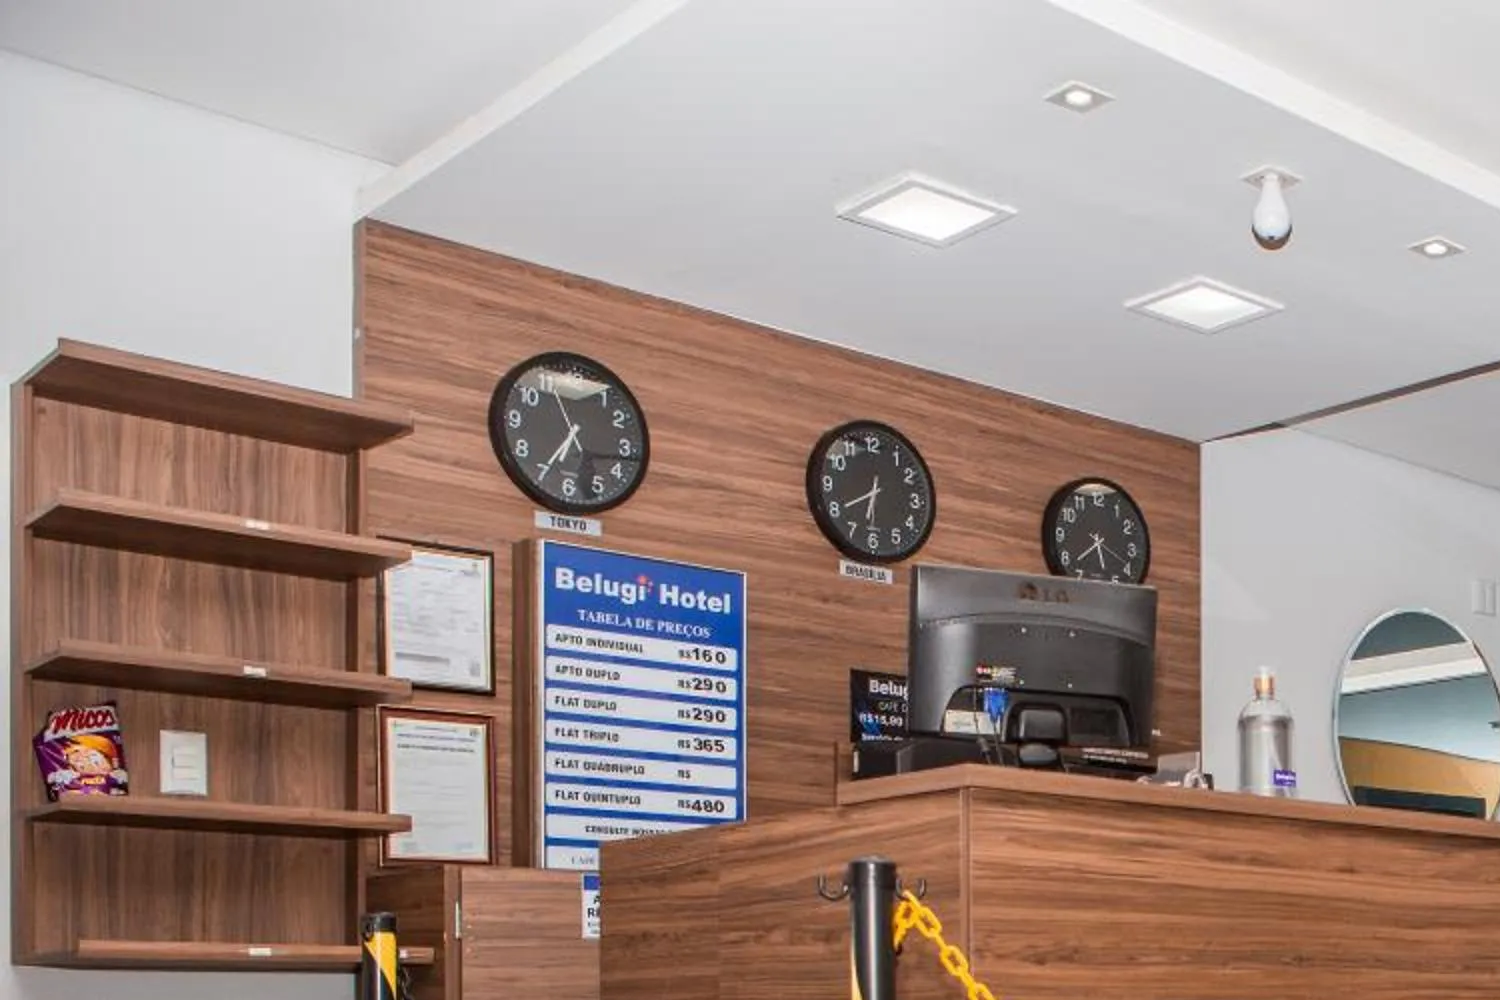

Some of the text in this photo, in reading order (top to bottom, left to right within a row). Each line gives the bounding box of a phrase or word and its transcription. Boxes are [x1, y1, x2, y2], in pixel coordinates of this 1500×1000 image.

[538, 373, 553, 393] 11
[520, 387, 539, 407] 10
[601, 391, 607, 408] 1
[509, 410, 521, 429] 9
[613, 410, 625, 429] 2
[516, 439, 528, 457] 8
[619, 439, 631, 457] 3
[844, 441, 855, 456] 11
[865, 436, 881, 454] 12
[828, 455, 846, 471] 10
[893, 451, 899, 467] 1
[537, 463, 549, 481] 7
[611, 462, 623, 479] 4
[904, 468, 914, 484] 2
[562, 478, 575, 496] 6
[592, 476, 604, 493] 5
[823, 475, 833, 492] 9
[910, 493, 920, 509] 3
[1074, 496, 1085, 511] 11
[1092, 491, 1104, 507] 12
[829, 501, 840, 518] 8
[1061, 507, 1077, 523] 10
[1114, 503, 1119, 518] 1
[550, 516, 587, 531] TOKYO
[847, 521, 857, 538] 7
[905, 514, 914, 529] 4
[1123, 519, 1132, 535] 2
[868, 533, 879, 549] 6
[891, 528, 901, 544] 5
[1055, 527, 1064, 542] 9
[1127, 543, 1136, 557] 3
[1061, 551, 1070, 566] 8
[1123, 561, 1131, 576] 4
[555, 566, 731, 614] Belugi Hotel
[577, 609, 711, 639] TABELA DE PREÇOS
[556, 633, 583, 645] APTO
[586, 637, 643, 653] INDIVIDUAL
[556, 665, 583, 676] APTO
[586, 668, 620, 680] DUPLO
[555, 696, 580, 707] FLAT
[584, 699, 617, 710] DUPLO
[555, 728, 579, 738] FLAT
[583, 729, 619, 742] TRIPLO
[555, 758, 579, 769] FLAT
[584, 761, 645, 775] QUADRUPLO
[555, 790, 579, 801] FLAT
[584, 791, 641, 805] QUINTUPLO
